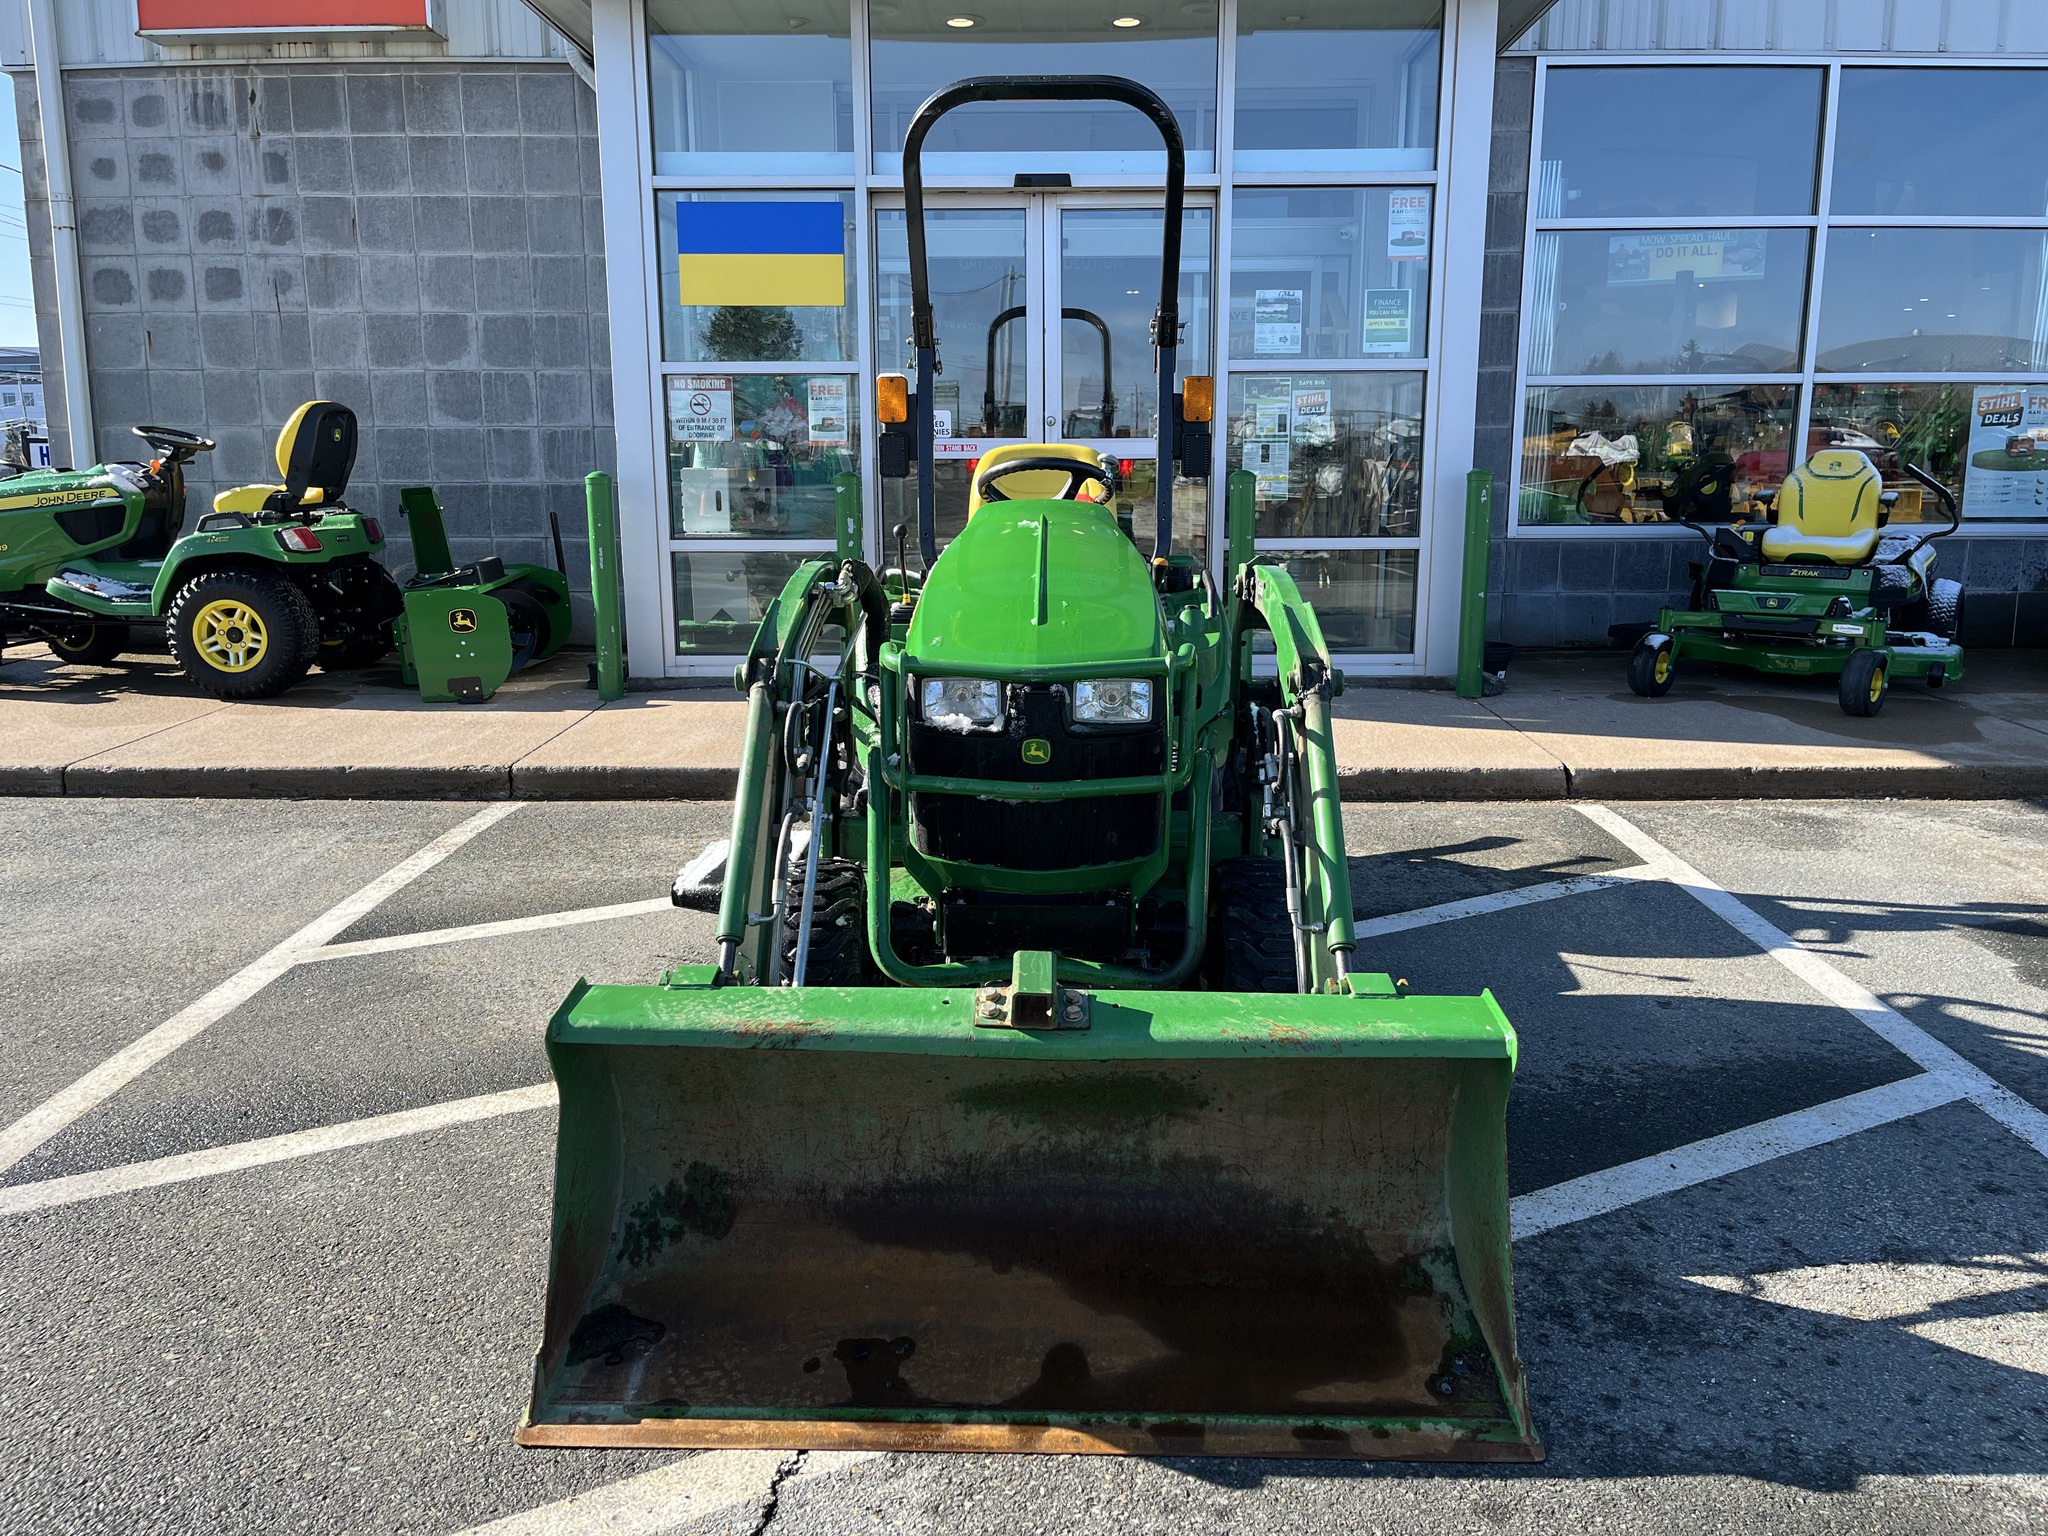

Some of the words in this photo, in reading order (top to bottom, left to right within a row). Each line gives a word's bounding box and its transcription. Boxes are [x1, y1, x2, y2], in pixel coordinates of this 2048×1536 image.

[1391, 196, 1426, 209] FREE
[1655, 247, 1674, 259] DO
[1677, 246, 1689, 258] IT
[1691, 245, 1718, 257] ALL.
[674, 379, 686, 389] NO
[687, 379, 726, 389] SMOKING
[810, 384, 843, 396] FREE
[1296, 394, 1324, 406] STIHL
[1979, 398, 2018, 412] STIHL
[2028, 396, 2048, 409] FR
[1300, 406, 1326, 415] DEALS
[1984, 413, 2020, 424] DEALS
[33, 495, 67, 507] JOHN
[67, 490, 106, 502] DEERE
[1789, 568, 1820, 577] ZTRAK
